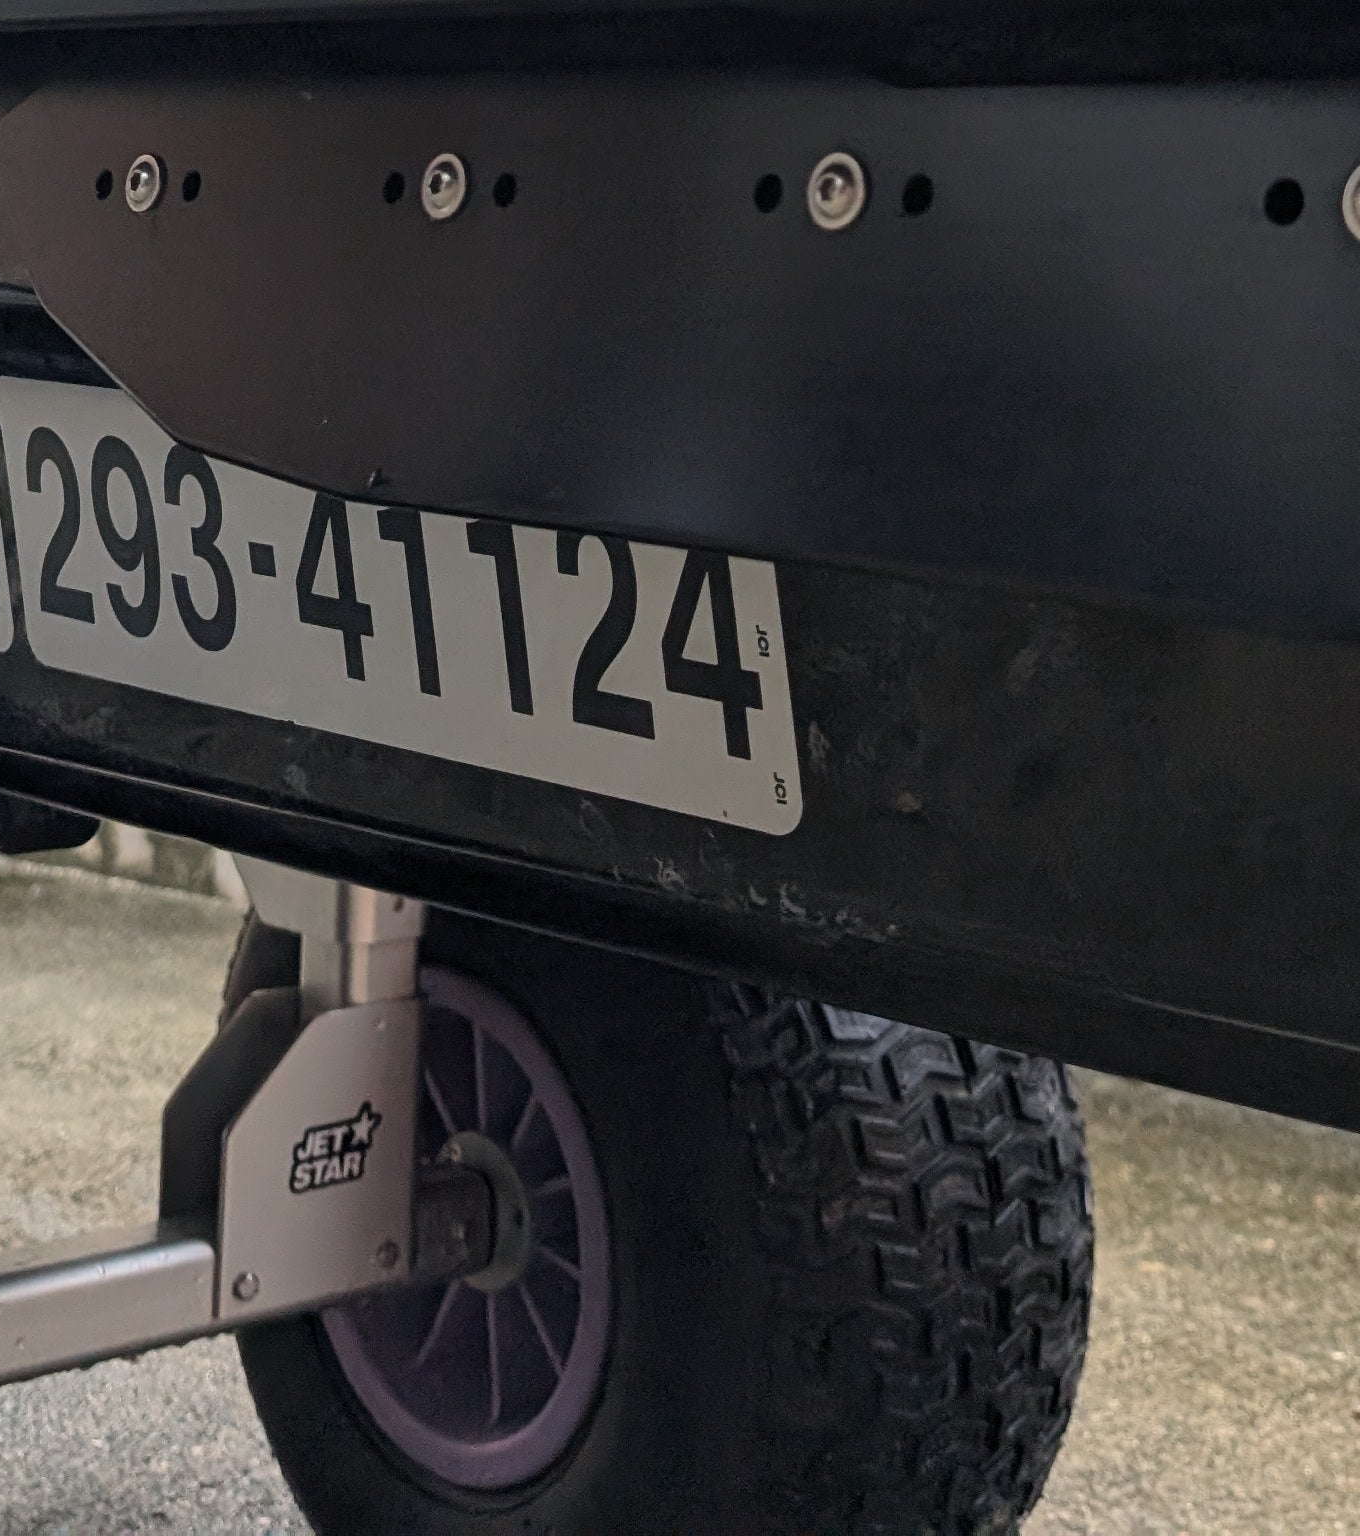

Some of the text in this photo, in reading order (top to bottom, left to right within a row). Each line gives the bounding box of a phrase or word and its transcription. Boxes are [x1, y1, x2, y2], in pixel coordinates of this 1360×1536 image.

[27, 427, 764, 761] 293-41124
[297, 1125, 350, 1161] JET
[293, 1151, 362, 1190] STAR
